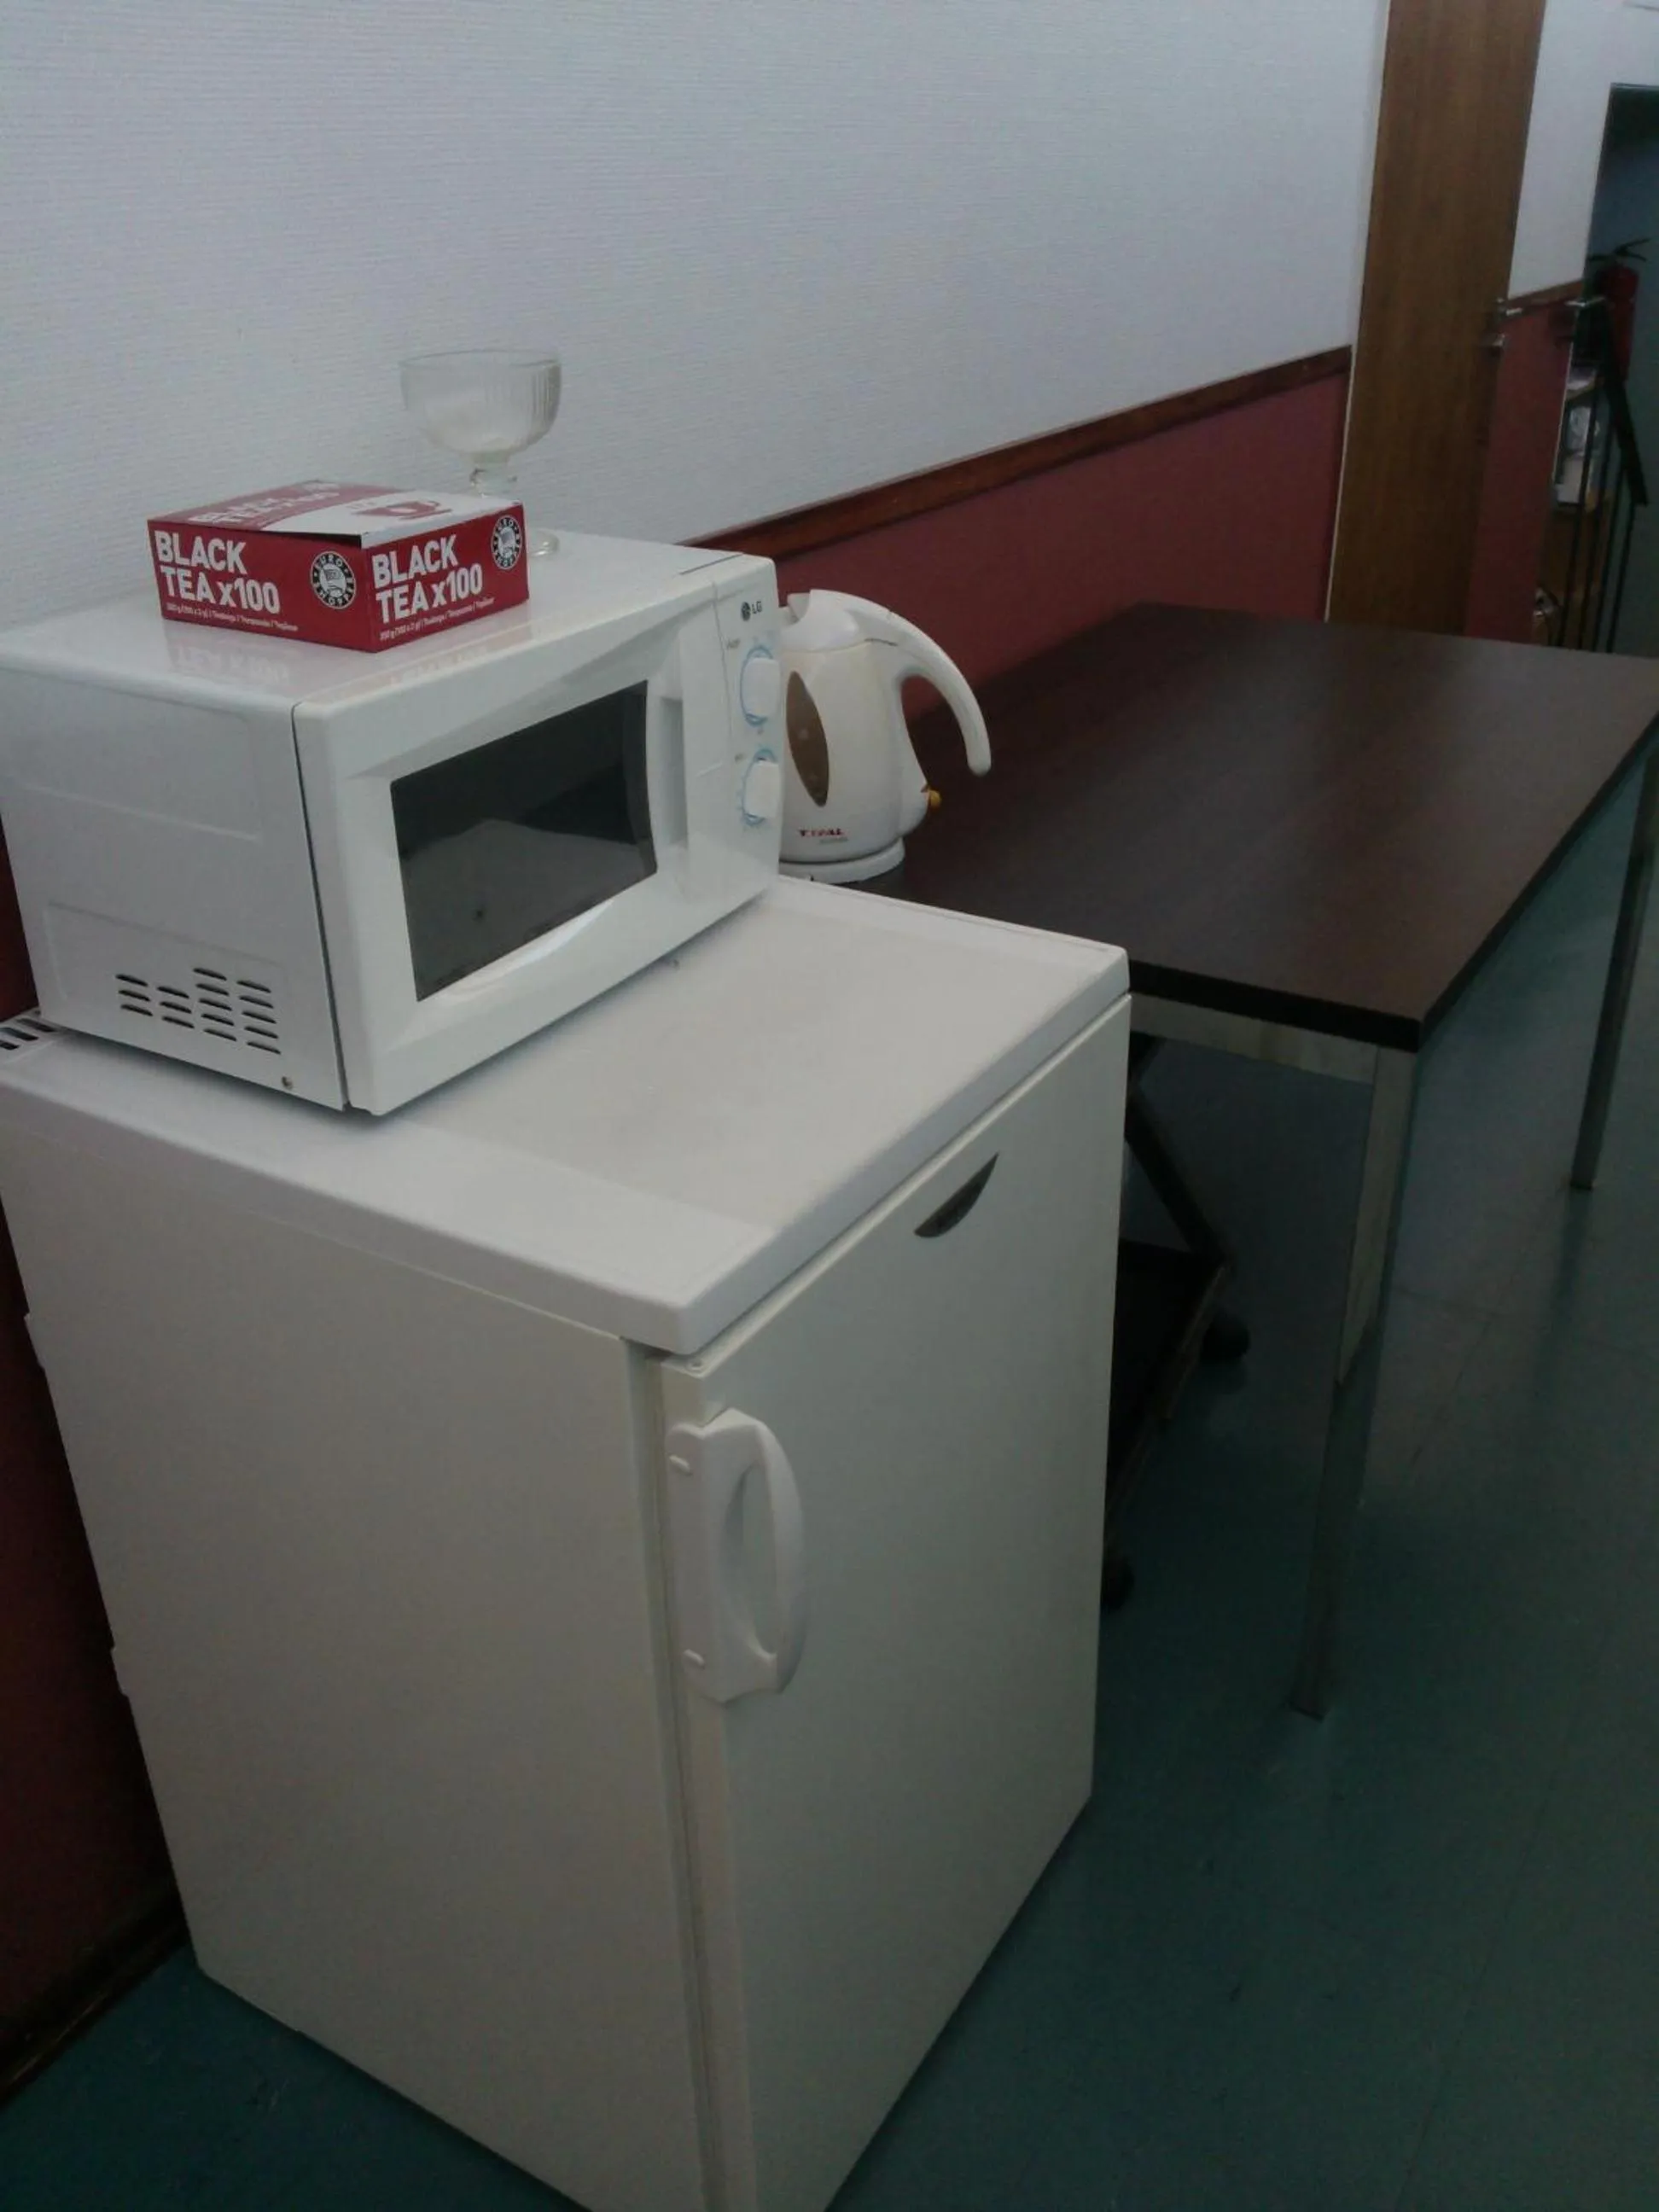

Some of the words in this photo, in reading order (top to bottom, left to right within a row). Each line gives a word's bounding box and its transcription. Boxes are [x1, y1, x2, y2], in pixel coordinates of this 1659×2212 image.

[154, 530, 247, 574] BLACK
[371, 534, 458, 589] BLACK
[160, 565, 216, 604] TEA
[217, 578, 281, 614] x100
[375, 580, 429, 624] TEA
[431, 563, 483, 608] x100
[751, 600, 763, 614] LG
